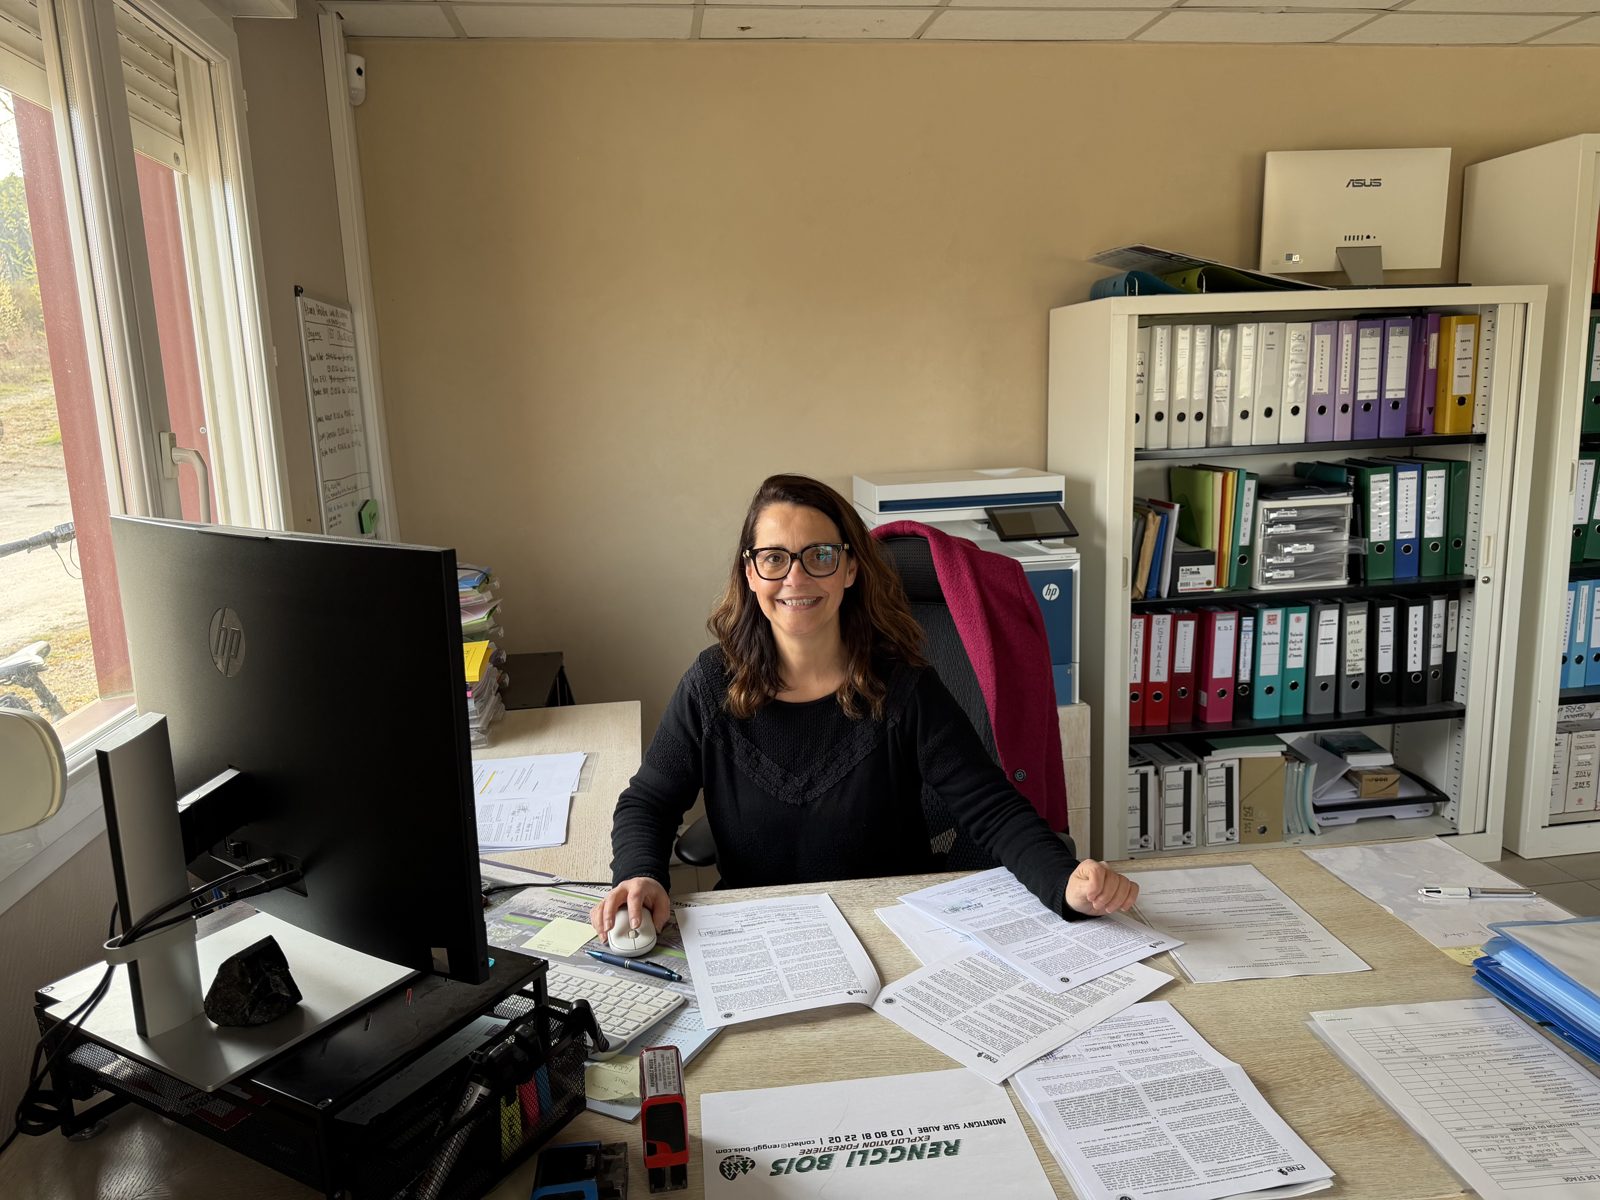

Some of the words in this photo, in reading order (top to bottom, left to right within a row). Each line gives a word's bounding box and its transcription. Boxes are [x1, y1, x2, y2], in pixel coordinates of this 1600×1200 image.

[1346, 178, 1382, 188] ASUS
[1044, 584, 1059, 600] hp
[213, 607, 242, 677] hp
[943, 1123, 960, 1131] SUR
[963, 1118, 1007, 1129] MONTIGNY
[890, 1129, 904, 1137] 03
[917, 1125, 940, 1134] AUBE
[828, 1136, 842, 1144] 02
[844, 1134, 857, 1142] 22
[861, 1132, 872, 1140] 81
[715, 1140, 816, 1154] contact@renggli-bois.com
[862, 1135, 931, 1149] EXPLOITATION
[845, 1138, 963, 1168] RENGGLI
[769, 1153, 836, 1176] BOIS
